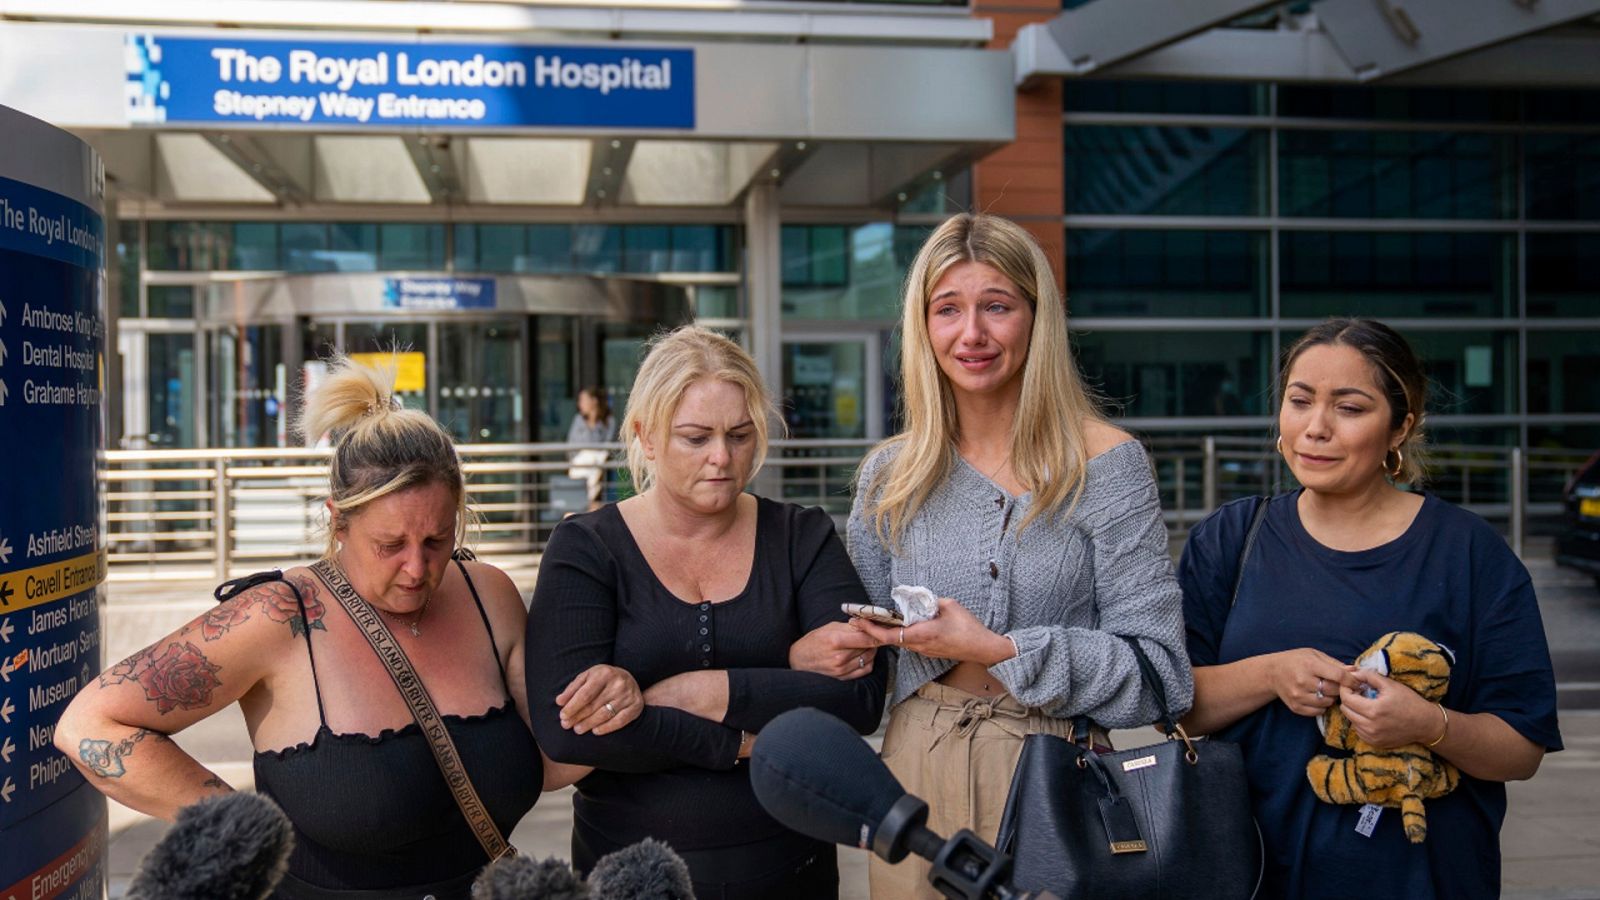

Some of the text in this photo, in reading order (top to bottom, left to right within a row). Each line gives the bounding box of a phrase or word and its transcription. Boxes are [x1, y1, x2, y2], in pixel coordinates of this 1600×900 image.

[211, 48, 671, 95] The Royal London Hospital
[213, 89, 486, 122] Stepney Way Entrance
[29, 206, 65, 245] Royal
[67, 218, 96, 253] London
[22, 302, 73, 332] Ambrose
[75, 310, 91, 341] King
[23, 341, 94, 375] Dental Hospital
[24, 379, 75, 404] Grahame
[27, 528, 73, 558] Ashfield
[25, 564, 96, 600] Cavell Entrance
[28, 608, 67, 635] James
[69, 596, 88, 622] Hora
[29, 642, 79, 674] Mortuary
[29, 676, 78, 712] Museum
[349, 595, 376, 628] RIVER
[370, 629, 403, 671] ISLAND
[408, 688, 434, 723] RIVER
[428, 723, 457, 771] ISLAND
[457, 786, 482, 820] RIVER
[475, 820, 502, 854] ISLAND
[31, 847, 88, 900] Emergency
